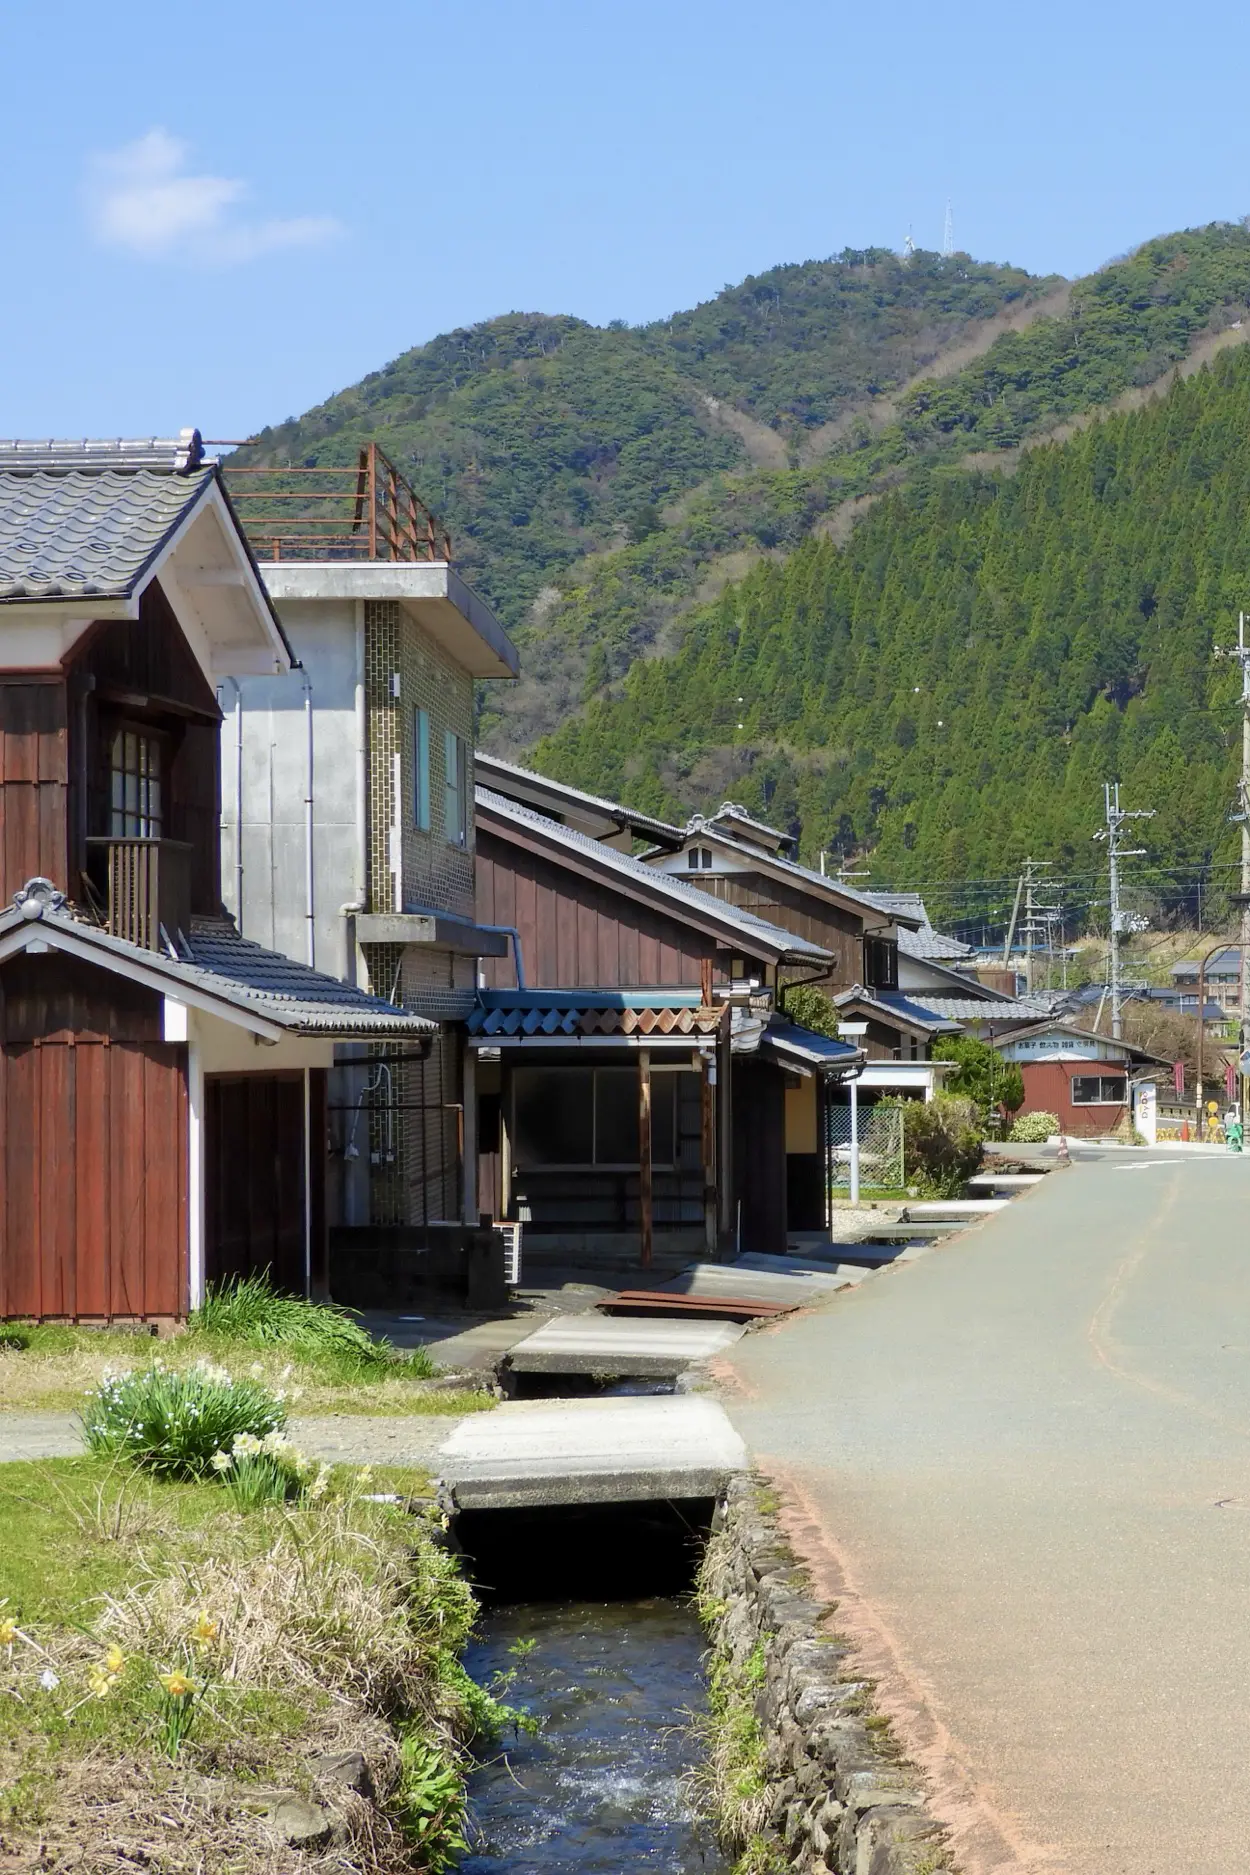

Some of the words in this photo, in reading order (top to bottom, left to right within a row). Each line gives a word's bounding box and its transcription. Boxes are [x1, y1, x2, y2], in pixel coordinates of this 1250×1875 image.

[1018, 1041, 1037, 1050] お菓子
[1039, 1041, 1060, 1050] 飲み物
[1061, 1041, 1075, 1050] 雑貨
